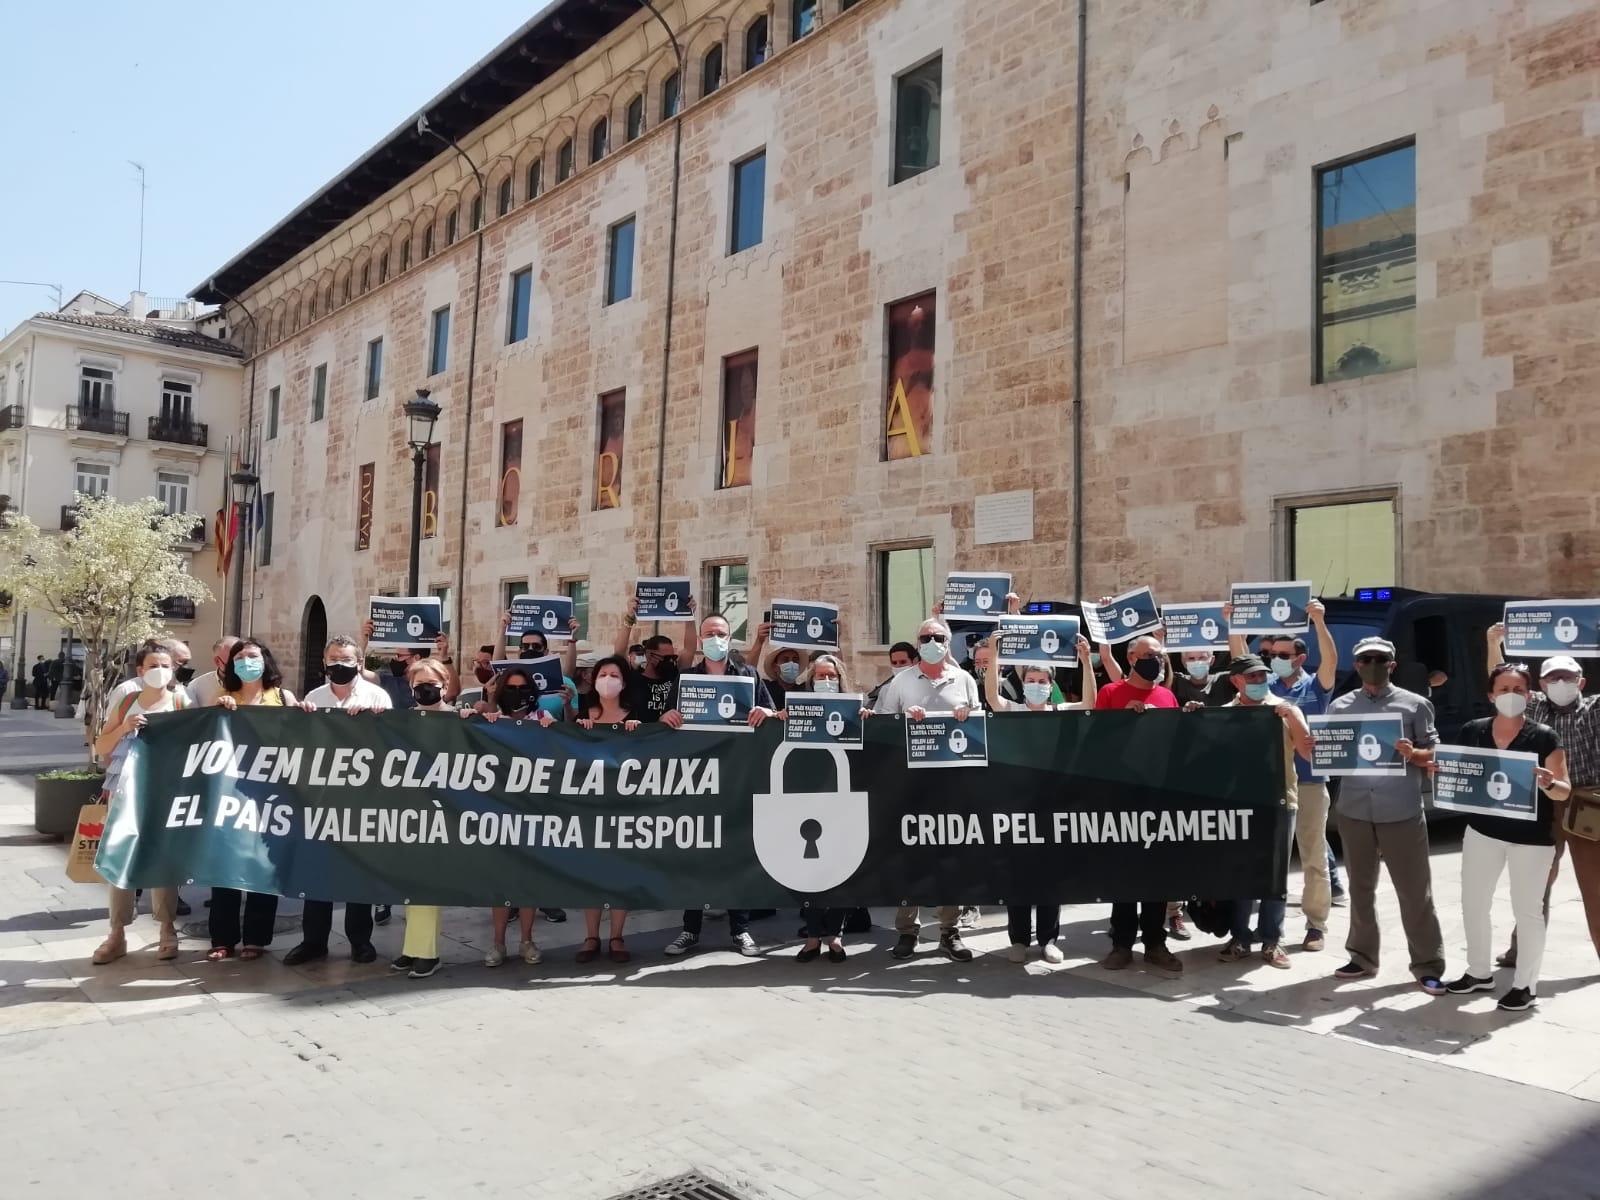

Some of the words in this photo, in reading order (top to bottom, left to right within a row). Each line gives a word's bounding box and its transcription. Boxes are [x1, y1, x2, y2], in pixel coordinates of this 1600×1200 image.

[599, 452, 621, 508] R
[887, 377, 921, 457] A
[182, 740, 304, 785] VOLEM
[308, 748, 374, 787] LES
[380, 748, 499, 792] CLAUS
[505, 756, 555, 793] DE
[560, 759, 605, 795] LA
[616, 758, 720, 796] CAIXA
[166, 794, 203, 828] EL
[214, 794, 293, 837] PAÍS
[303, 800, 449, 844] VALENCIÀ
[458, 810, 584, 848] CONTRA
[594, 815, 722, 849] L'ESPOLI
[900, 813, 984, 846] CRIDA
[992, 812, 1045, 845] PEL
[1053, 808, 1254, 849] FINANÇAMENT
